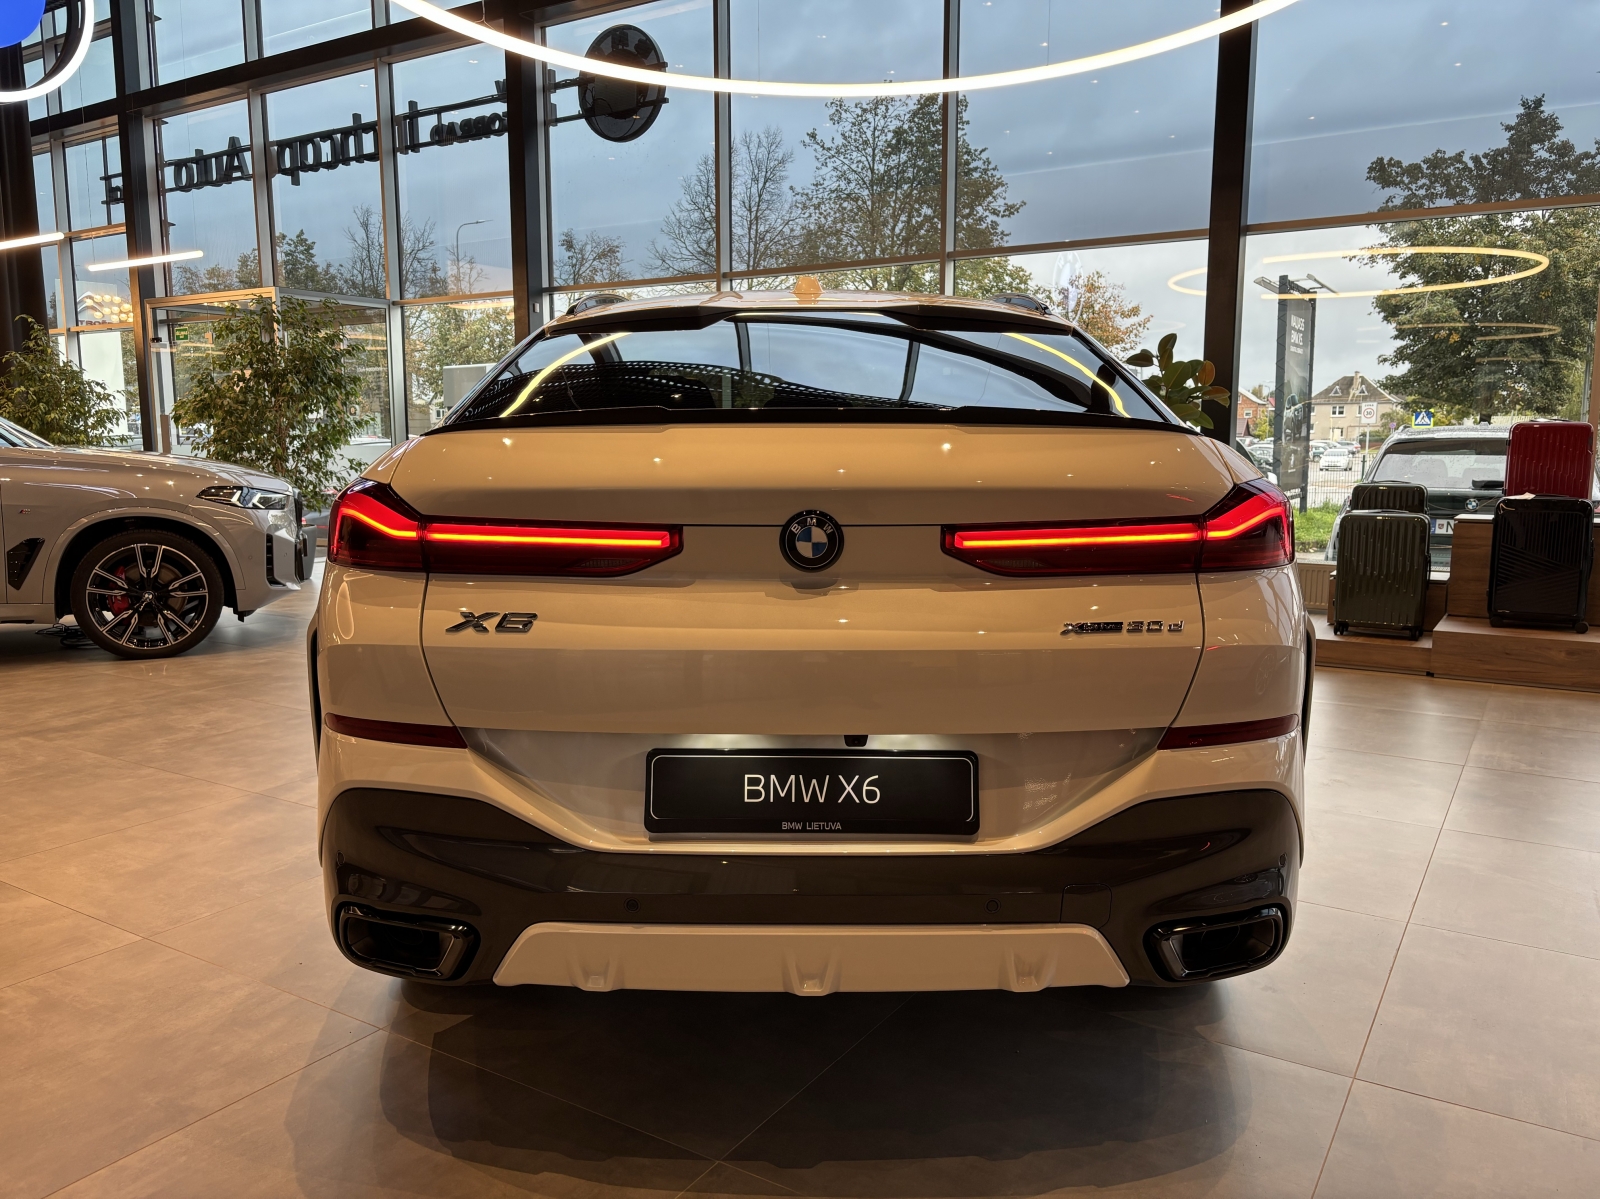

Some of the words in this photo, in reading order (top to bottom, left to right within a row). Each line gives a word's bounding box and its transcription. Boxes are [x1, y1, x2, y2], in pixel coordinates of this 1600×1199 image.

[791, 517, 833, 534] BMW
[445, 612, 538, 633] X6
[744, 774, 830, 803] BMW
[837, 774, 881, 804] X6
[781, 821, 803, 830] BMW
[806, 821, 842, 830] LIETUVA
